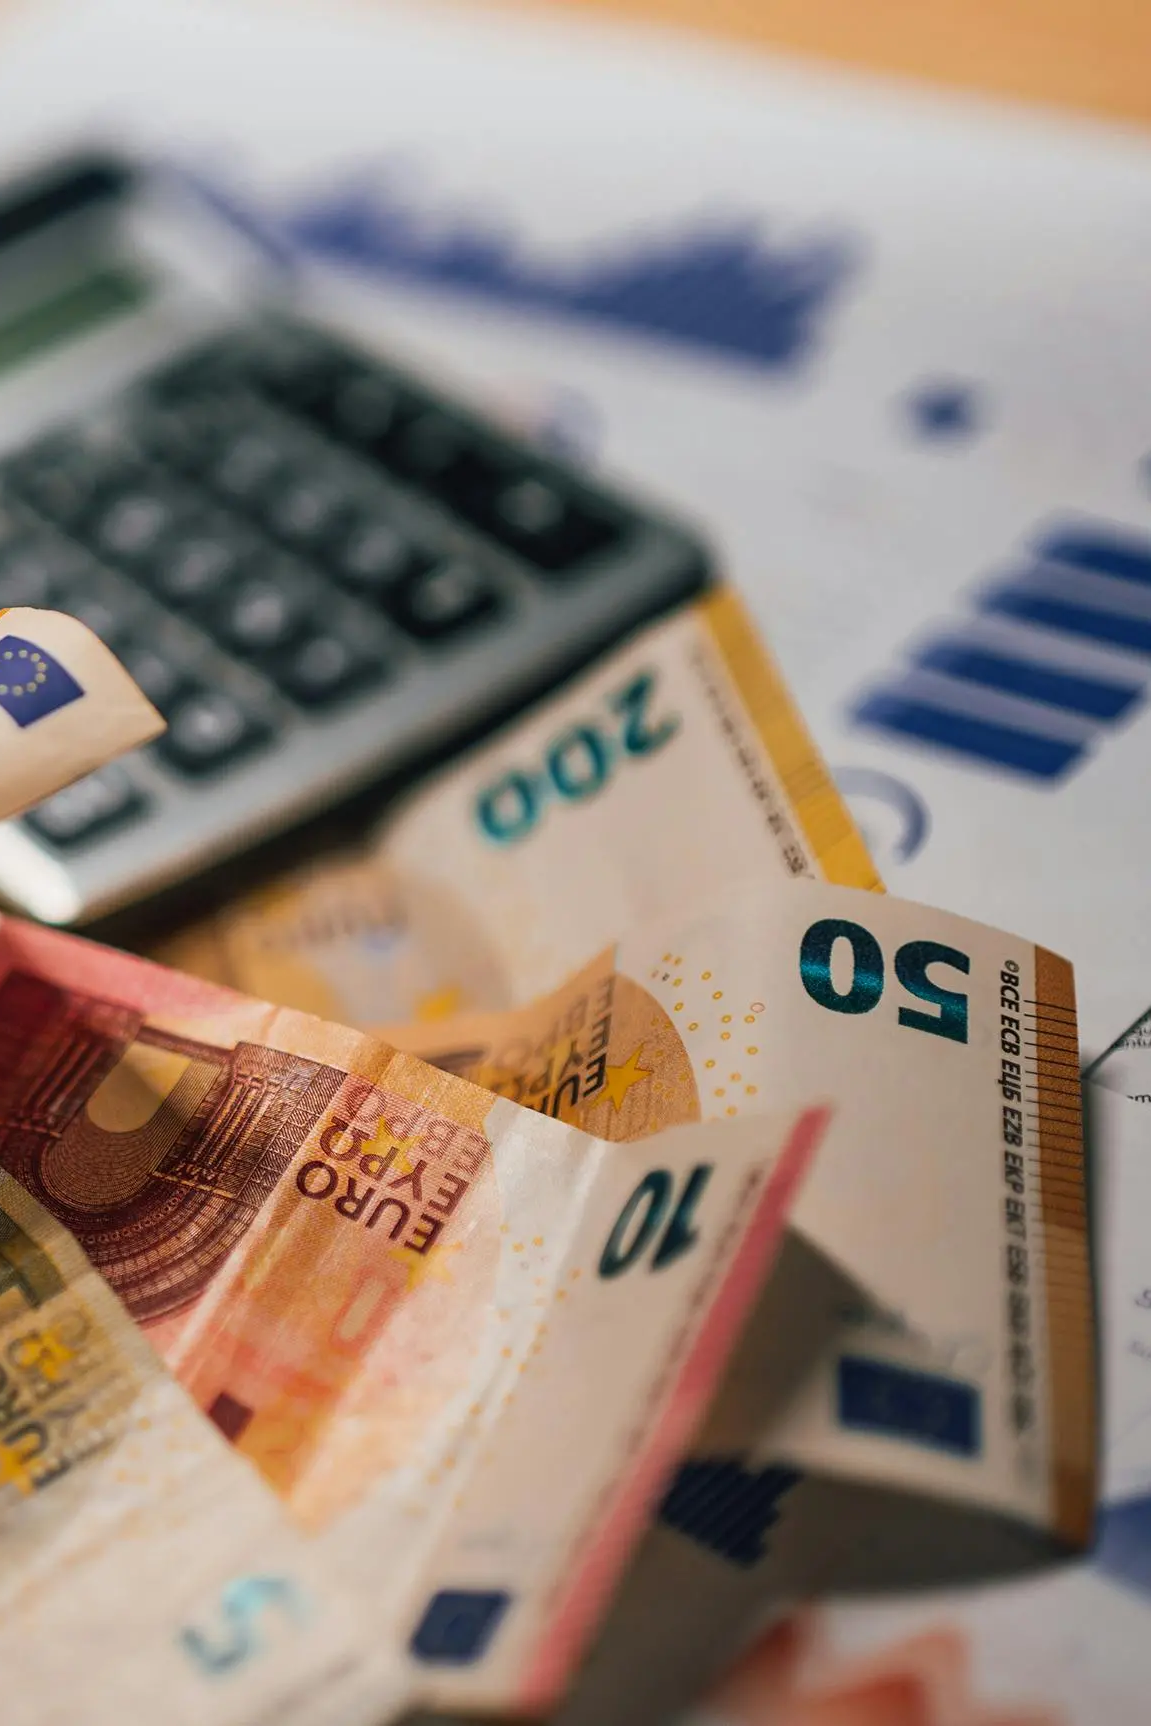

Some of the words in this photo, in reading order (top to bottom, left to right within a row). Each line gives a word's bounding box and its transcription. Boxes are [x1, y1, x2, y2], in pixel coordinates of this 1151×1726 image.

[477, 672, 681, 842] 200
[799, 918, 970, 1044] 50
[1000, 1014, 1021, 1057] ECB
[1002, 1105, 1024, 1149] EZB
[1003, 1150, 1026, 1195] EKP
[296, 1160, 446, 1256] EURO
[599, 1163, 712, 1278] 10
[179, 1575, 310, 1682] 5
